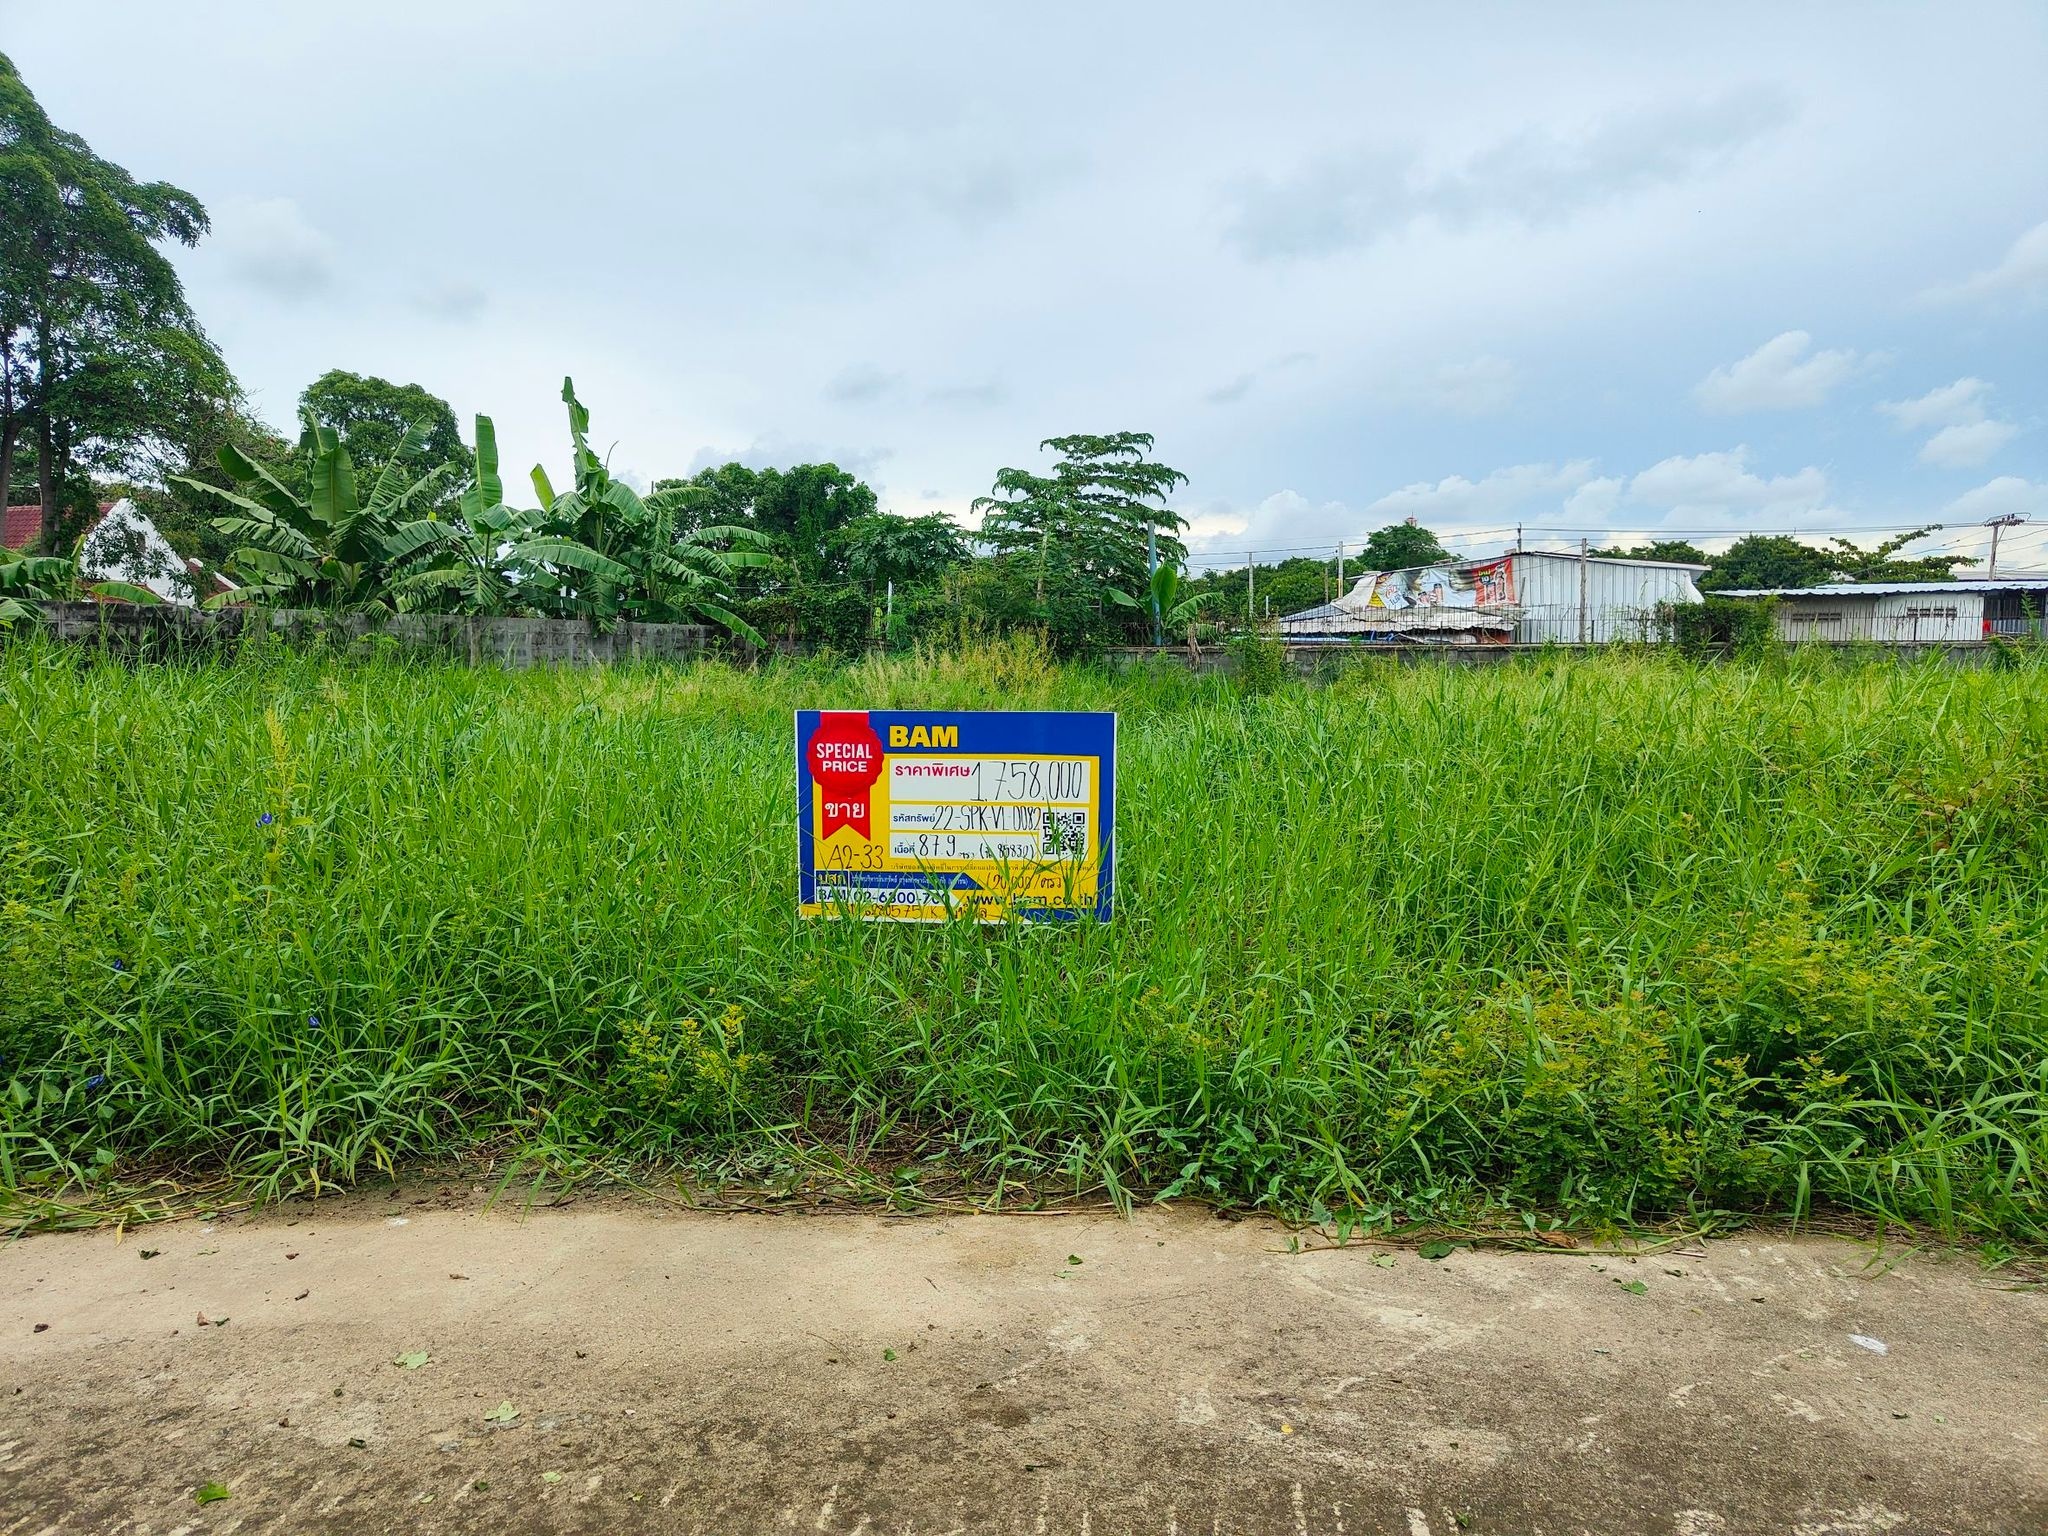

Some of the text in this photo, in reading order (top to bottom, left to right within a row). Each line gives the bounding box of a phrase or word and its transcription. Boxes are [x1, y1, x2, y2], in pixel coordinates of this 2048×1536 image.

[889, 725, 958, 748] BAM
[816, 743, 873, 759] SPECIAL
[822, 760, 868, 773] PRICE
[895, 761, 1082, 802] ราคาพิเศษ 1,758,000
[824, 802, 865, 819] ขาย
[892, 813, 936, 823] รหัสทรัพย์
[894, 842, 915, 854] เนื้อที่
[826, 844, 884, 869] A2-33
[818, 889, 846, 900] BAM
[967, 892, 1093, 906] www.bam.coth
